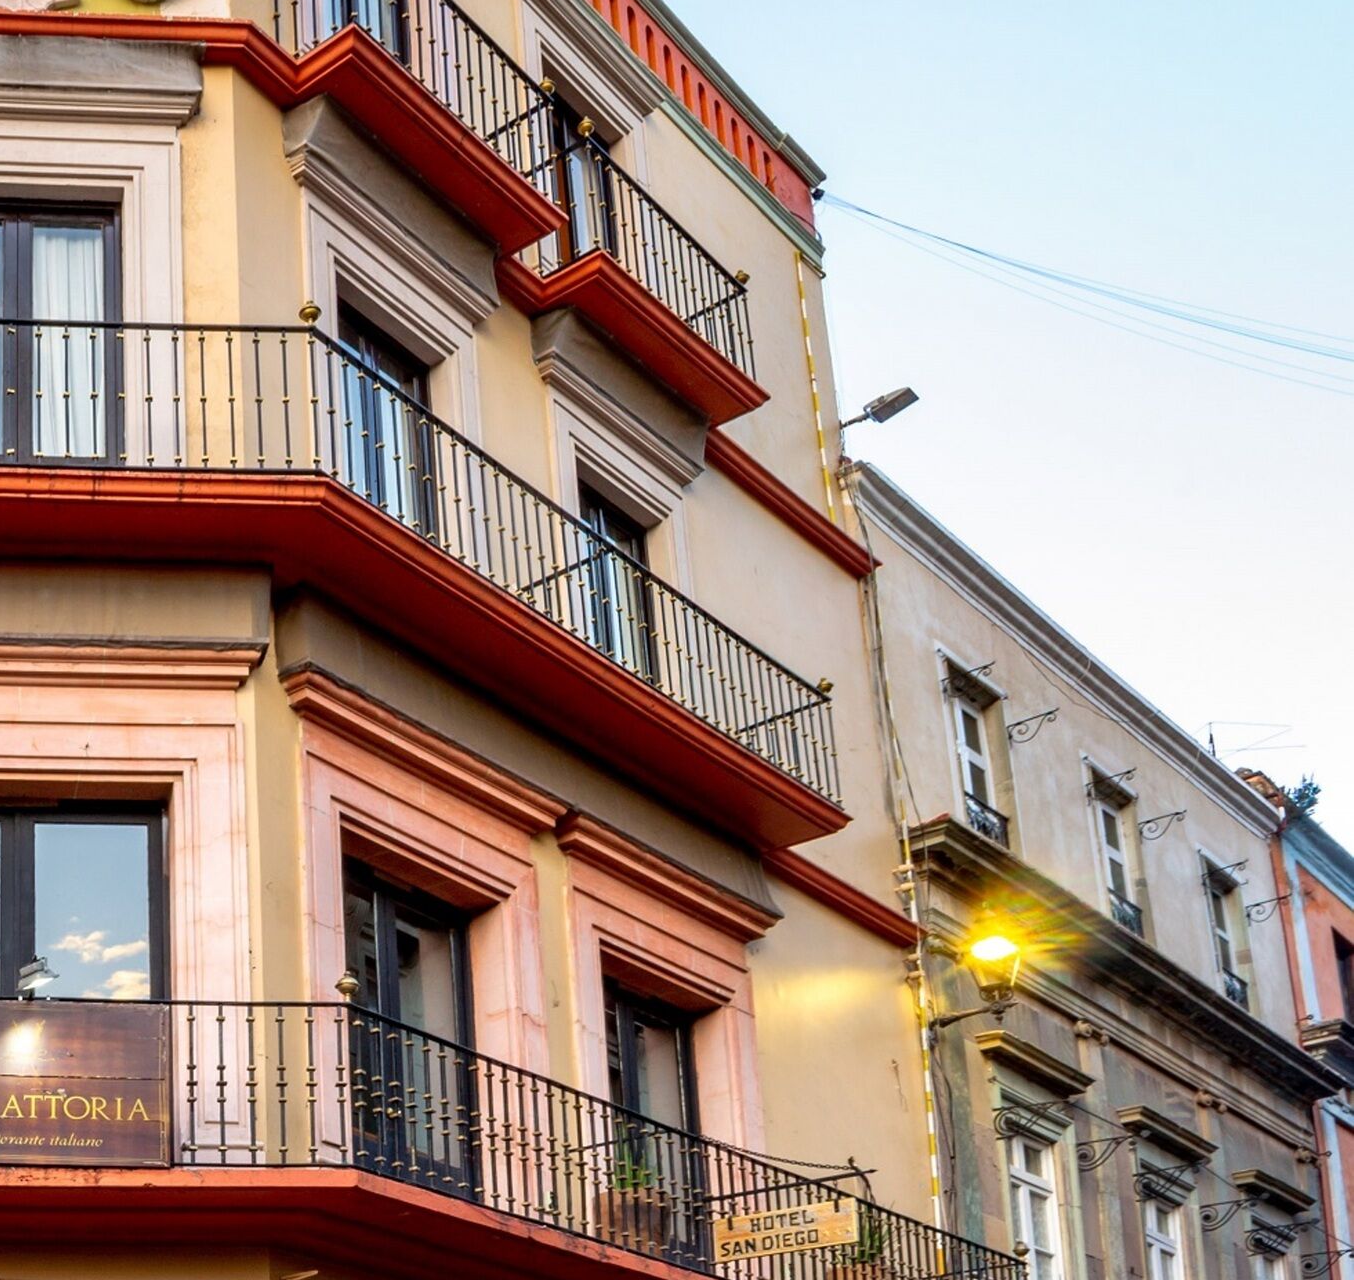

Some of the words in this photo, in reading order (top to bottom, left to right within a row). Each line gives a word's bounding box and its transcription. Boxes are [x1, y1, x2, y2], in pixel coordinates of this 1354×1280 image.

[49, 1132, 104, 1148] italiano
[750, 1209, 815, 1233] HOTEL
[720, 1238, 757, 1258] SAN
[762, 1229, 819, 1251] DIEGO
